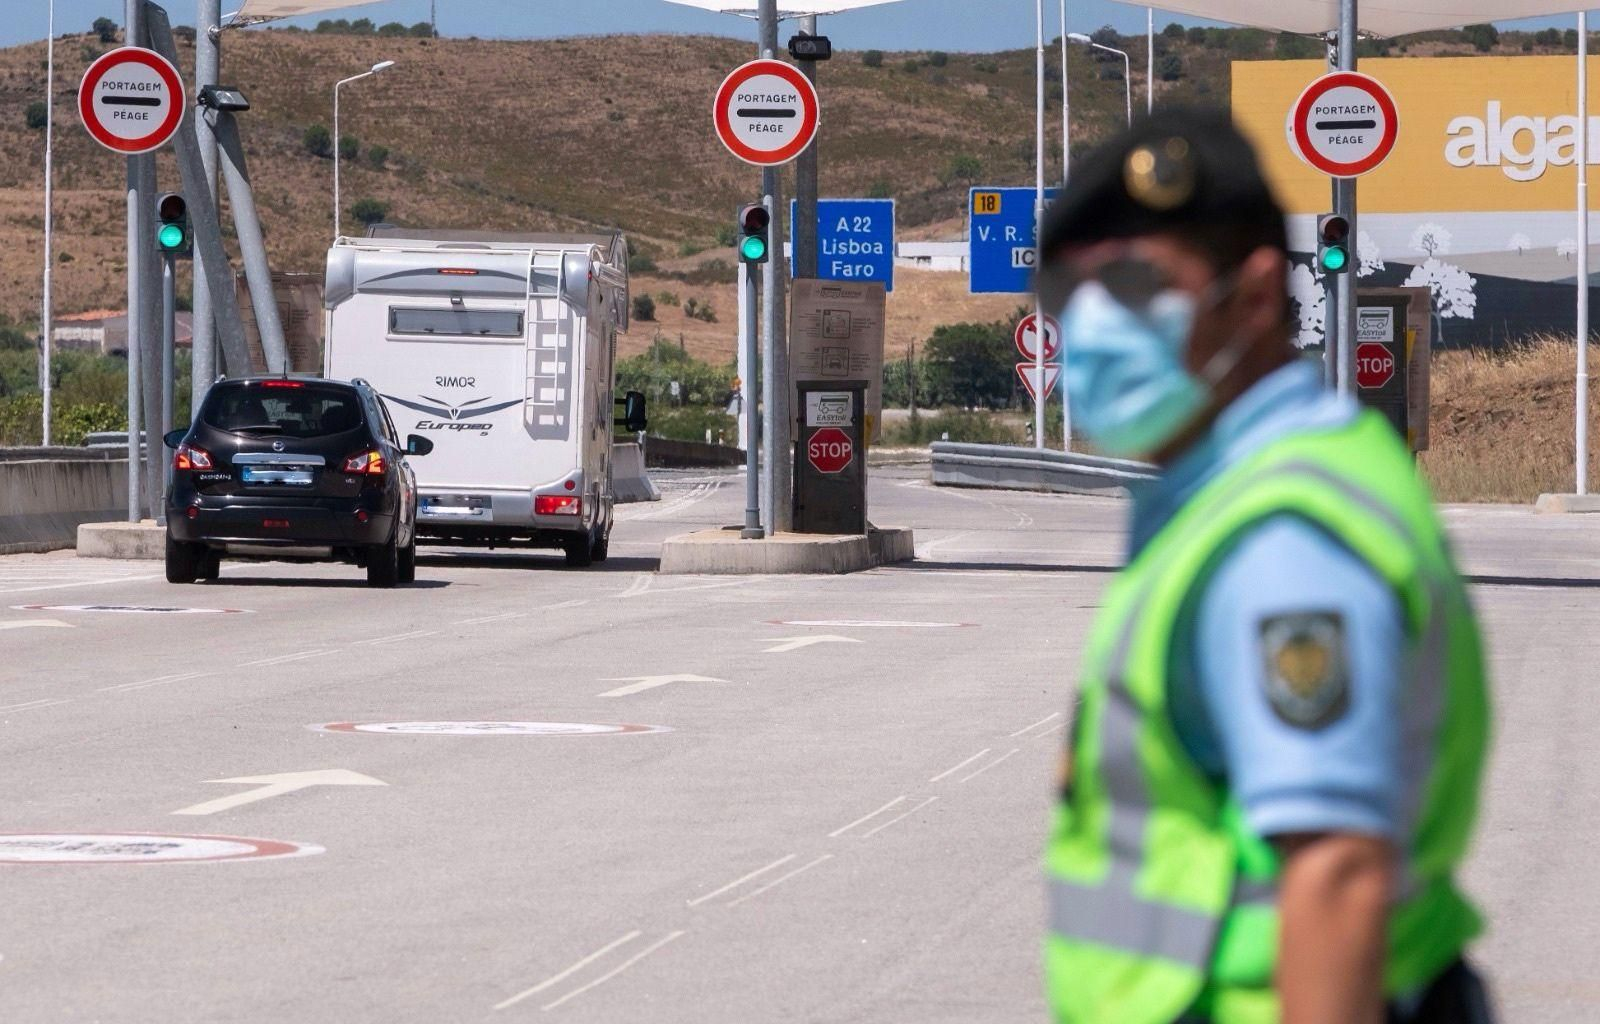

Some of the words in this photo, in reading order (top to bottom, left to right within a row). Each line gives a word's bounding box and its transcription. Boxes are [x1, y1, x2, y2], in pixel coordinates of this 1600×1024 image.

[102, 81, 161, 91] PORTAGEM
[738, 94, 796, 103] PORTAGEM
[113, 109, 149, 120] PÉAGE
[1315, 105, 1376, 115] PORTAGEM
[749, 122, 783, 132] PÉAGE
[1328, 134, 1364, 144] PÉAGE
[981, 195, 996, 211] 18
[836, 217, 850, 232] A
[853, 216, 871, 232] 22
[822, 239, 883, 255] Lisboa
[832, 261, 874, 277] Faro
[435, 376, 475, 388] RIMOR
[810, 442, 851, 458] STOP
